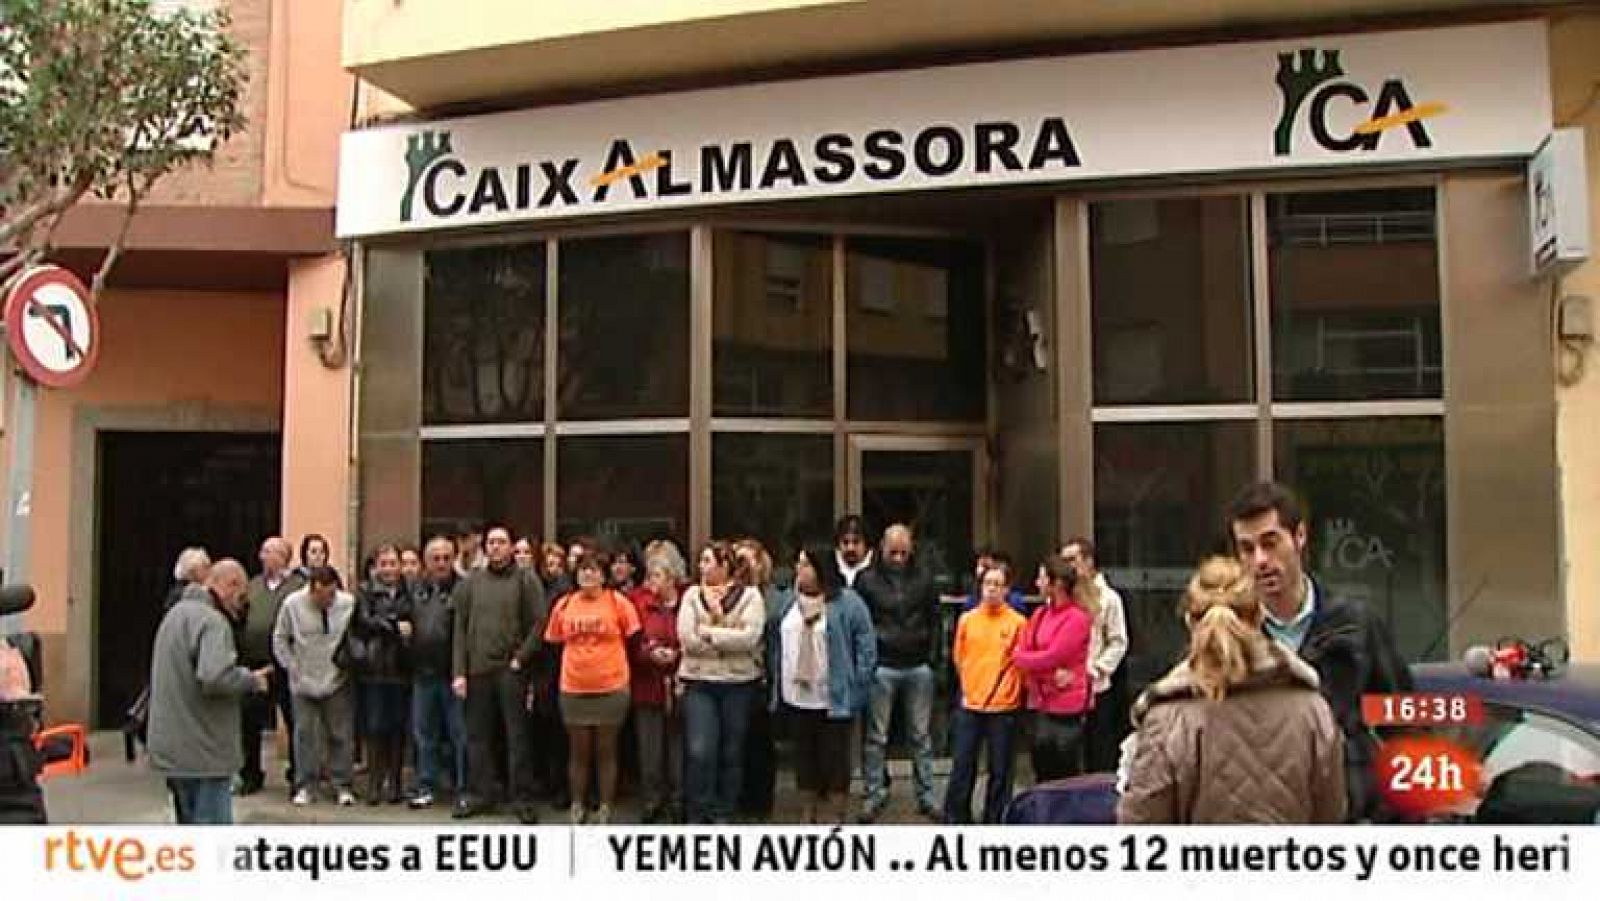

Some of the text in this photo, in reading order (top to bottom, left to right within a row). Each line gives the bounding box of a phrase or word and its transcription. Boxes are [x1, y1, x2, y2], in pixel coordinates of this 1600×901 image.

[1310, 78, 1432, 151] CA
[423, 116, 1082, 217] CAIX ALMASSORA
